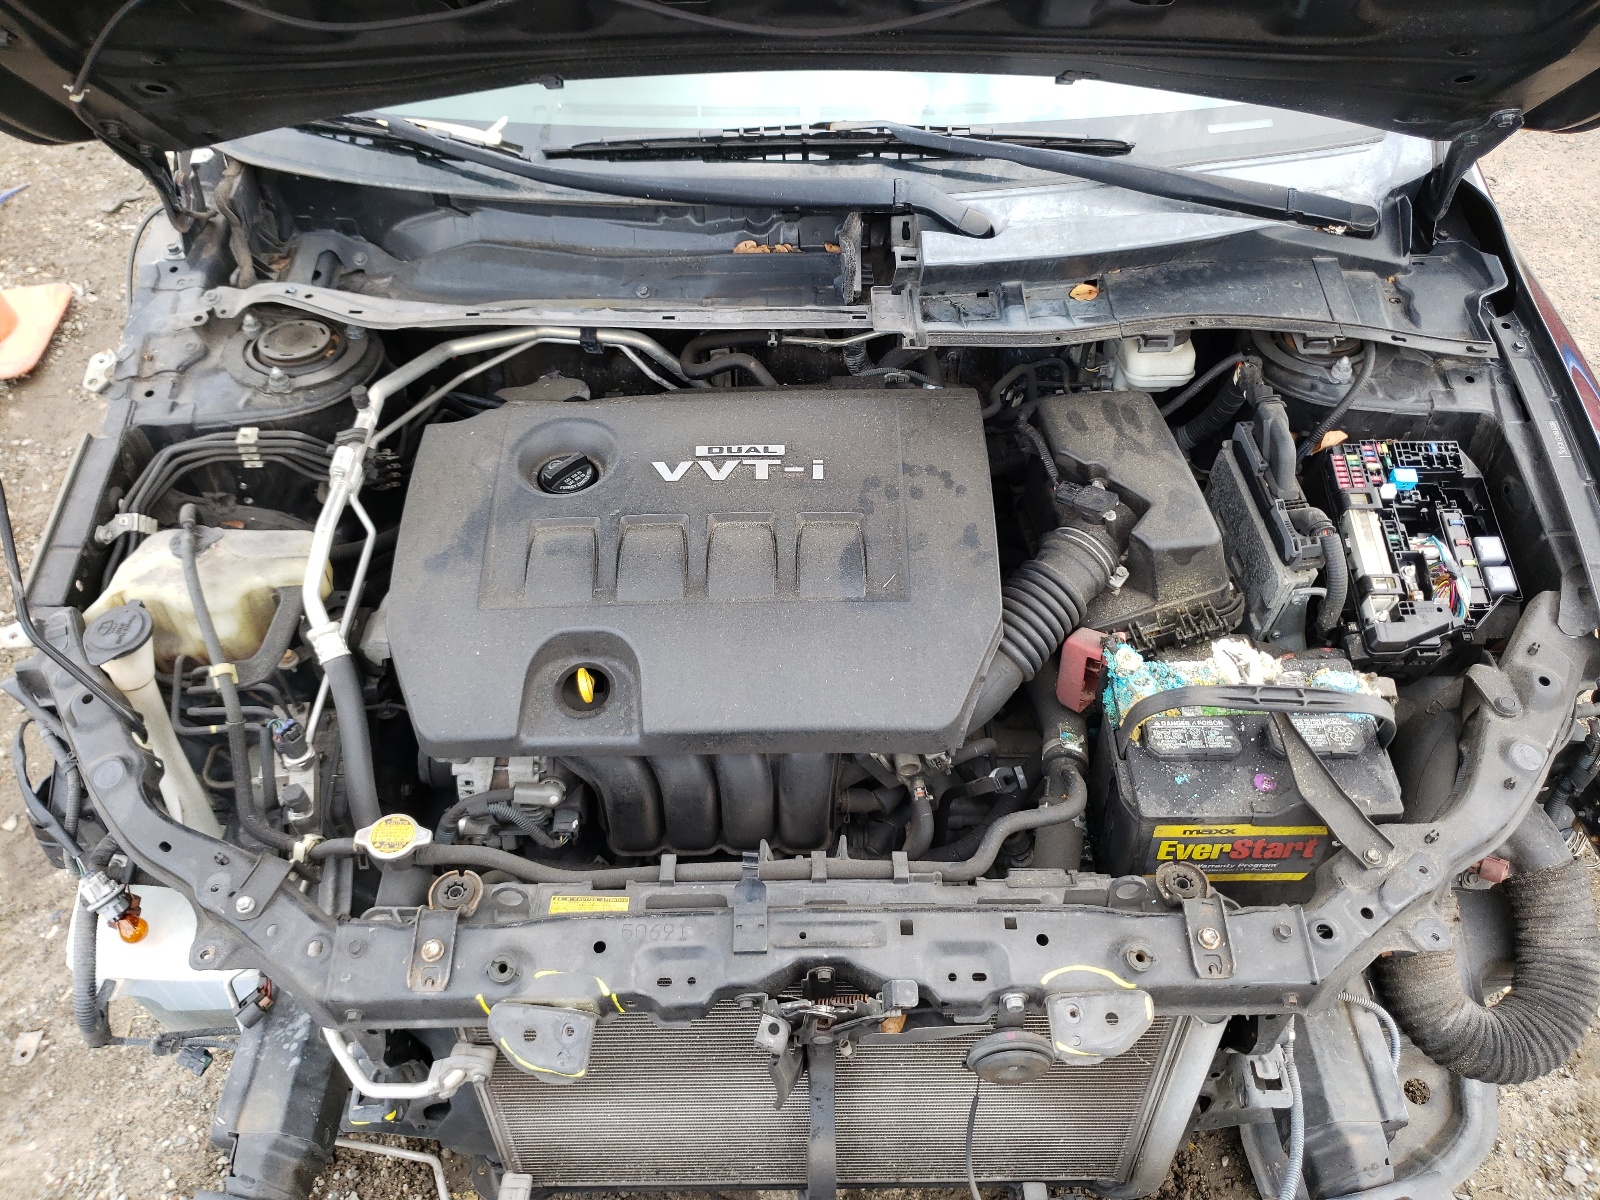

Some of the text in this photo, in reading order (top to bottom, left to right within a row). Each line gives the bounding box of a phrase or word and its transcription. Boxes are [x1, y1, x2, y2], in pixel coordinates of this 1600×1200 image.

[707, 445, 778, 455] DUAL
[651, 459, 824, 482] VVT-i
[1156, 838, 1319, 861] EverStart
[621, 923, 687, 941] 50691
